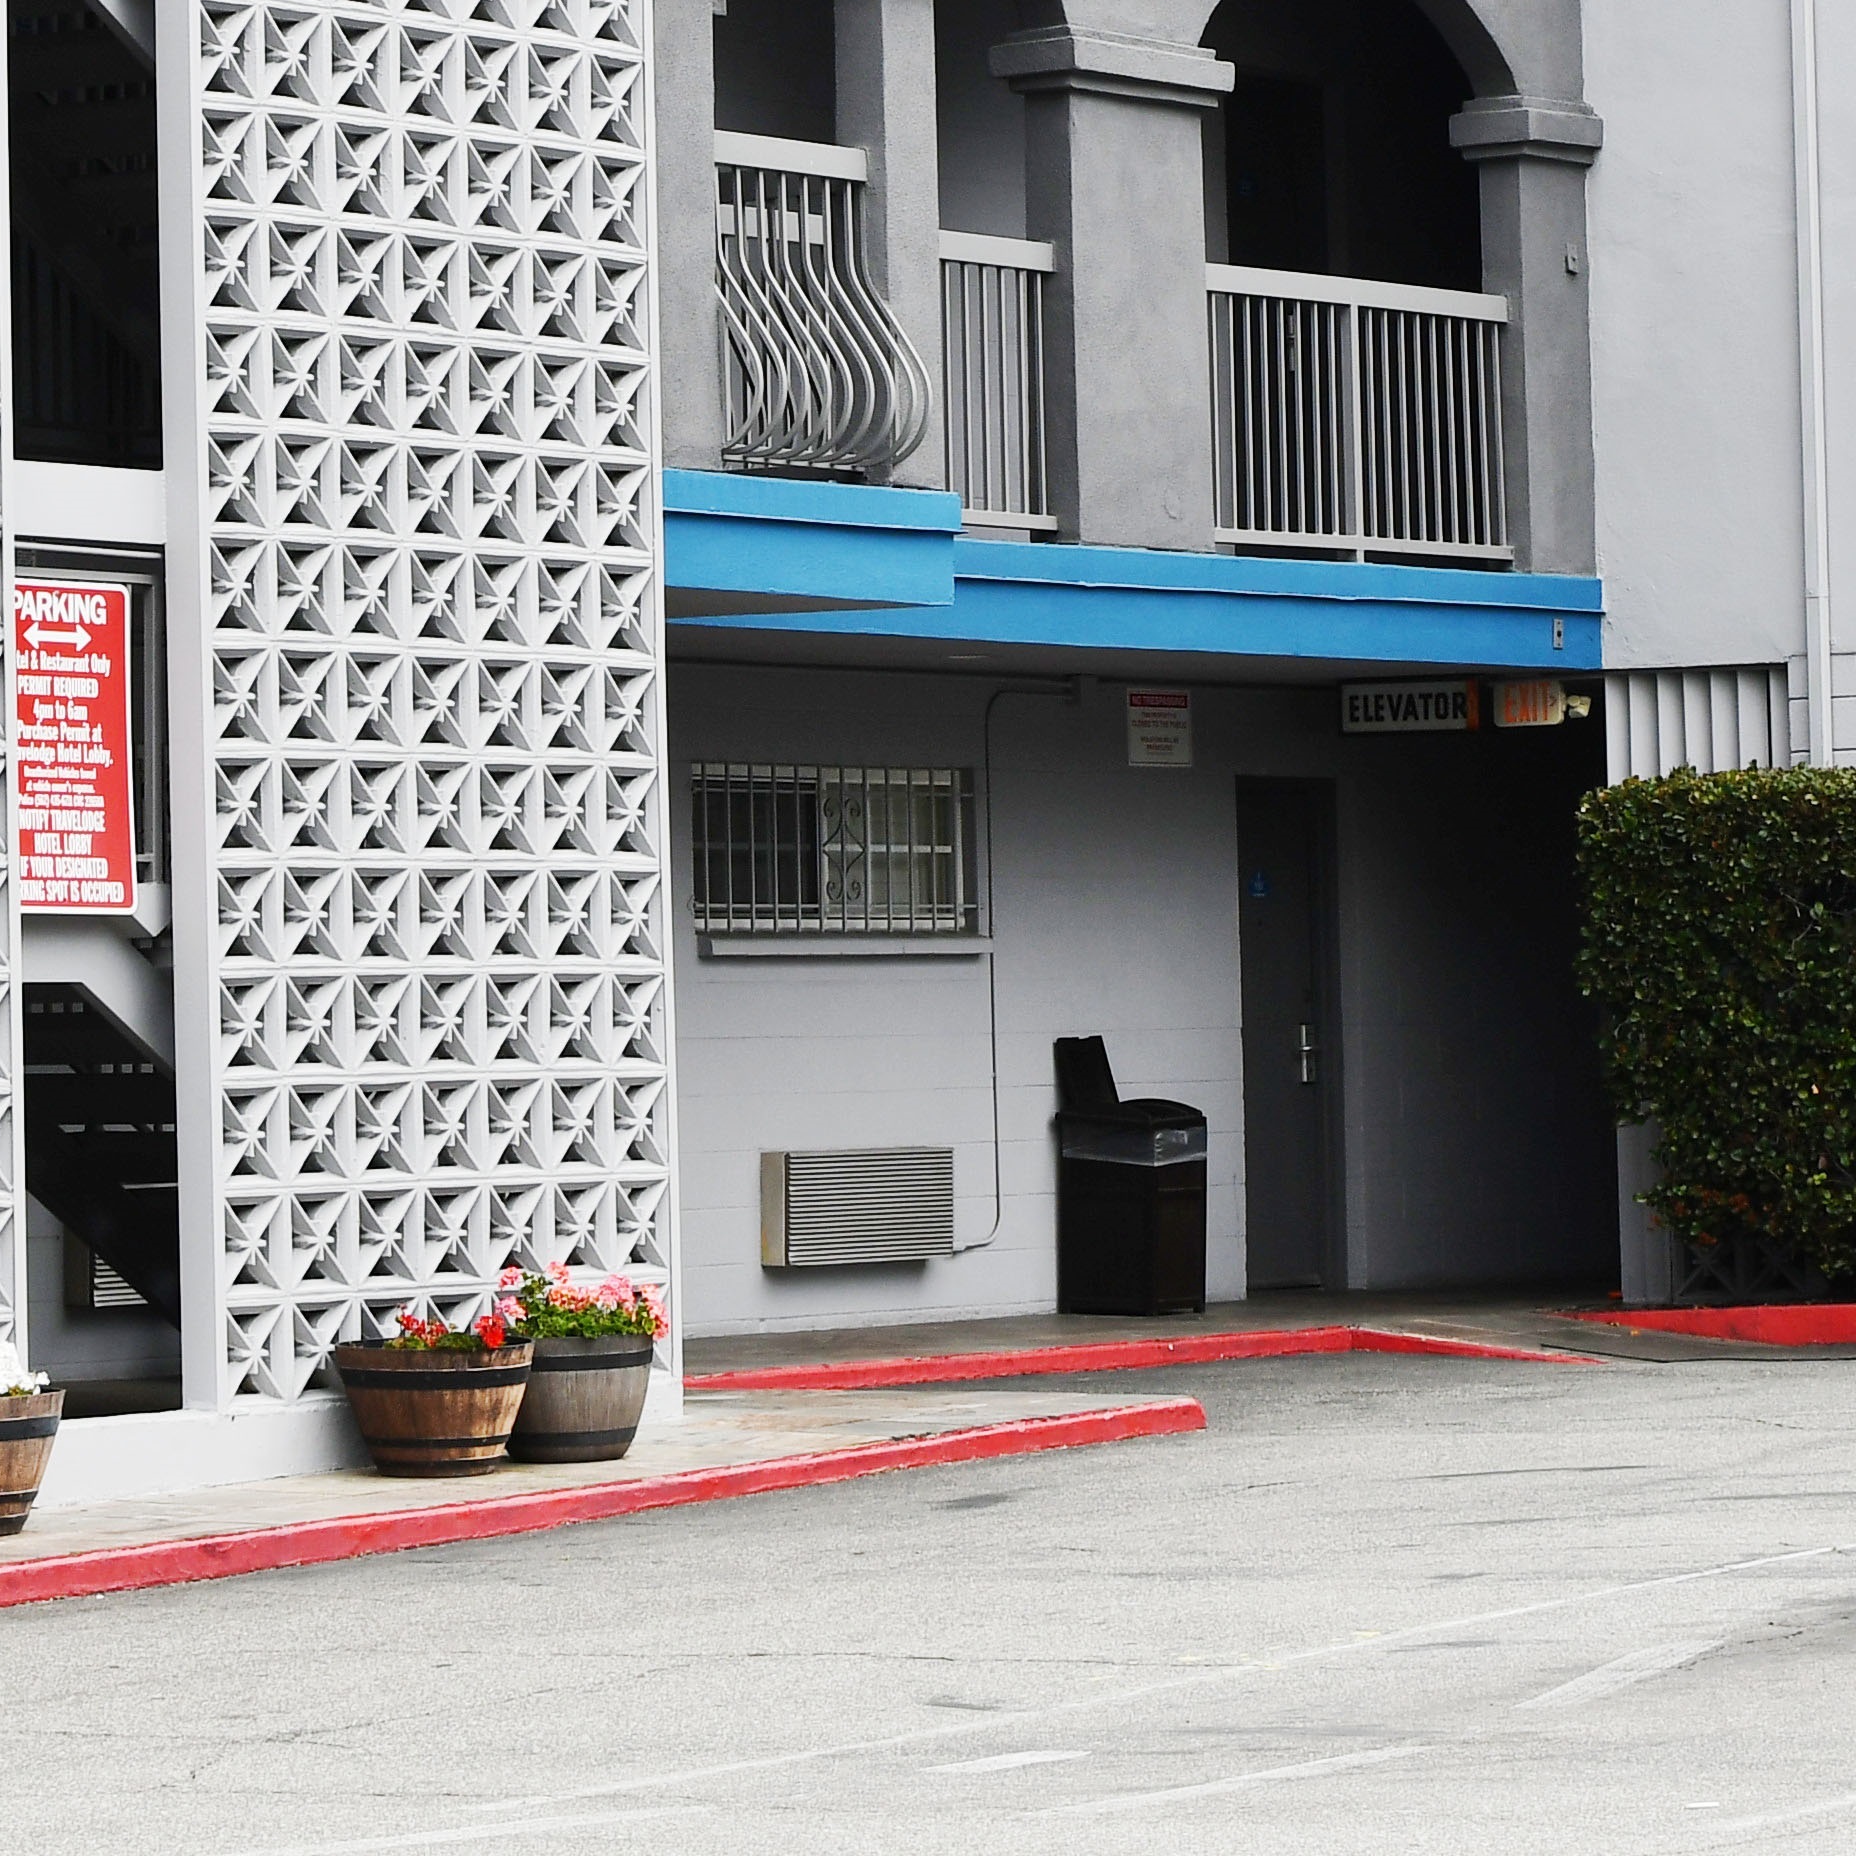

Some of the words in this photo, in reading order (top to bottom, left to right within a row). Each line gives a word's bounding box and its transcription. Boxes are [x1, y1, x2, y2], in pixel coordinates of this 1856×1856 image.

[14, 590, 107, 625] PARKING
[16, 649, 29, 669] tel
[30, 649, 39, 670] &
[40, 650, 90, 673] Restaurant
[90, 652, 111, 677] Only
[17, 674, 52, 696] PERMIT
[53, 676, 99, 699] REQUIRED
[33, 698, 54, 723] 4pm
[55, 700, 66, 720] to
[67, 700, 88, 721] 6am
[1349, 692, 1468, 723] ELEVATOR
[1505, 681, 1550, 723] EXIT
[17, 719, 59, 741] Purchase
[59, 721, 90, 742] Permit
[91, 723, 103, 743] at
[16, 742, 56, 765] avelodge
[57, 742, 82, 763] Hotel
[83, 743, 114, 768] Lobby.
[19, 809, 49, 831] NOTIFY
[50, 810, 106, 832] TRAVELODGE
[34, 832, 63, 854] HOTEL
[64, 833, 93, 855] LOBBY
[20, 856, 29, 877] IF
[30, 856, 54, 878] YOUR
[55, 857, 109, 880] DESIGNATED
[46, 880, 69, 903] SPOT
[69, 881, 80, 903] IS
[81, 881, 125, 903] OCCUPIED
